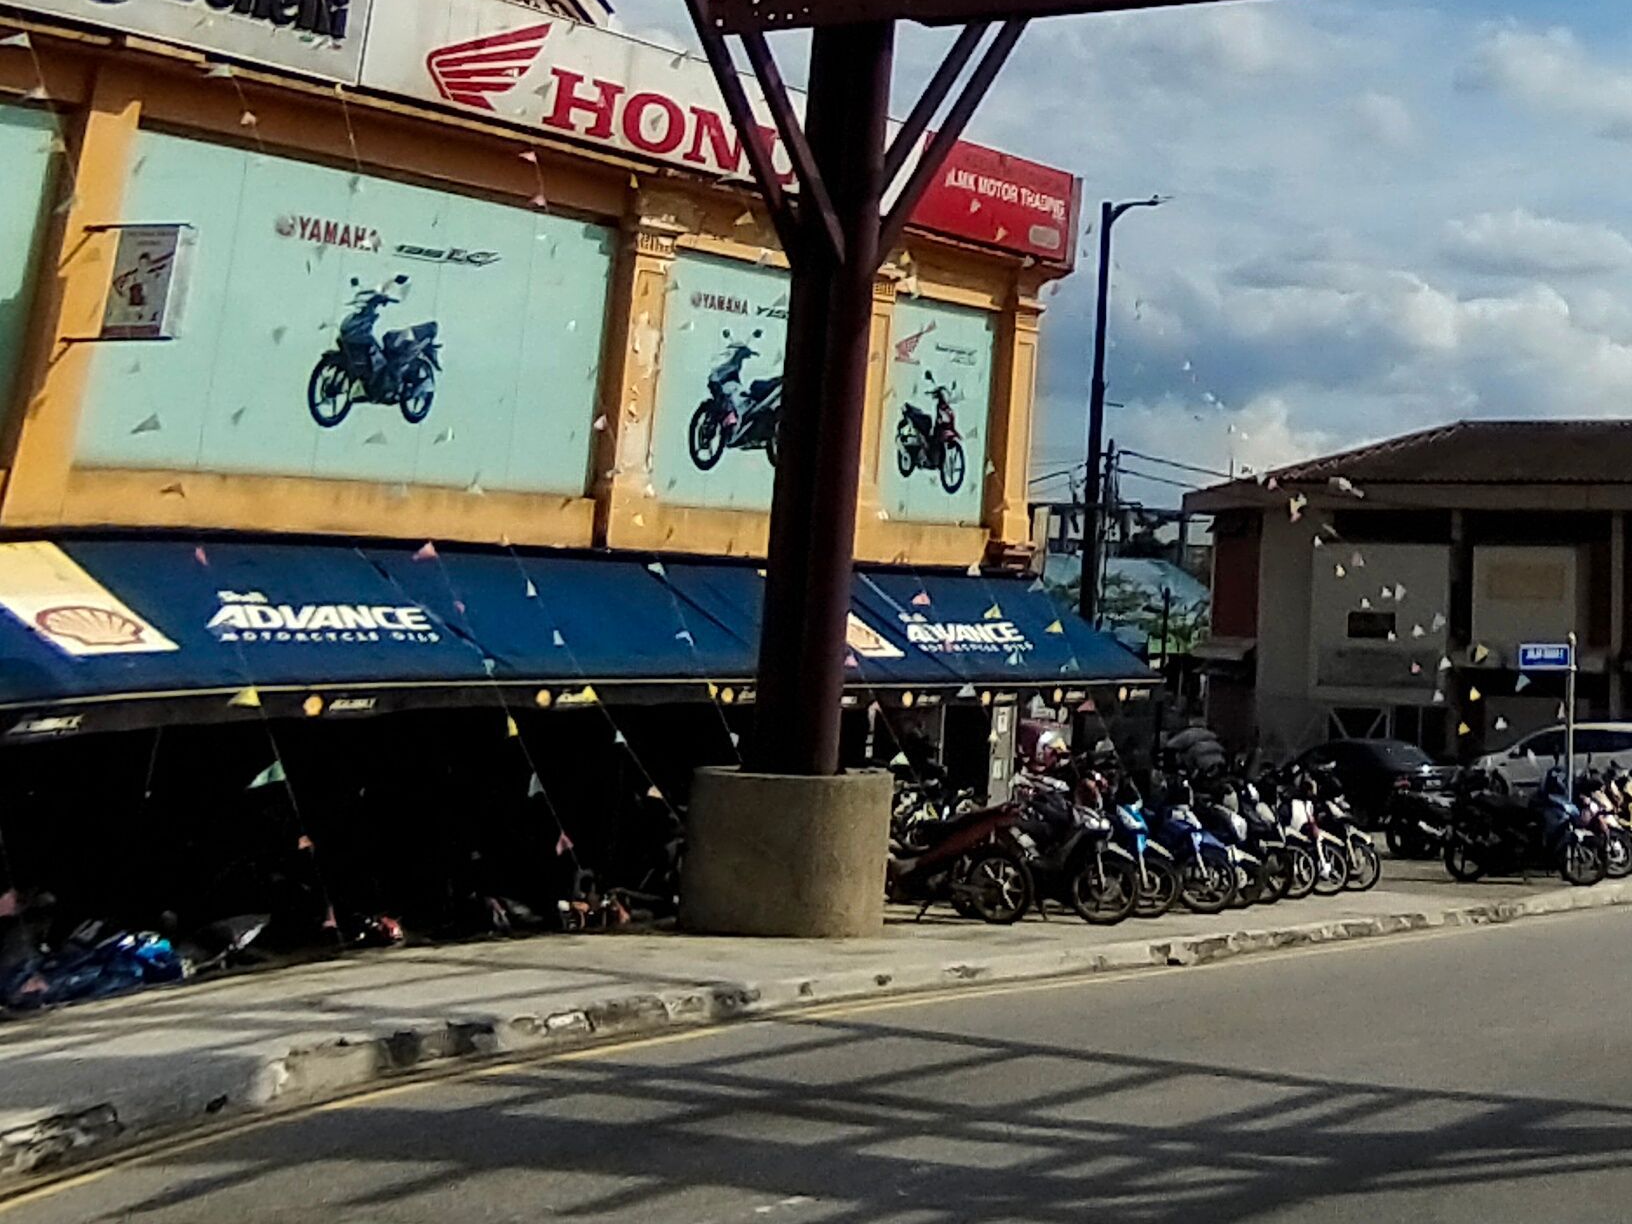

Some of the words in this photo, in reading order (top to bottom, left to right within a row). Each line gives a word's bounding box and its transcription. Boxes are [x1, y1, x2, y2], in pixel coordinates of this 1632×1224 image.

[542, 66, 795, 184] HON
[977, 176, 1019, 204] MOTOR
[205, 604, 433, 631] ADVANCE
[906, 621, 1025, 644] ADVANCE
